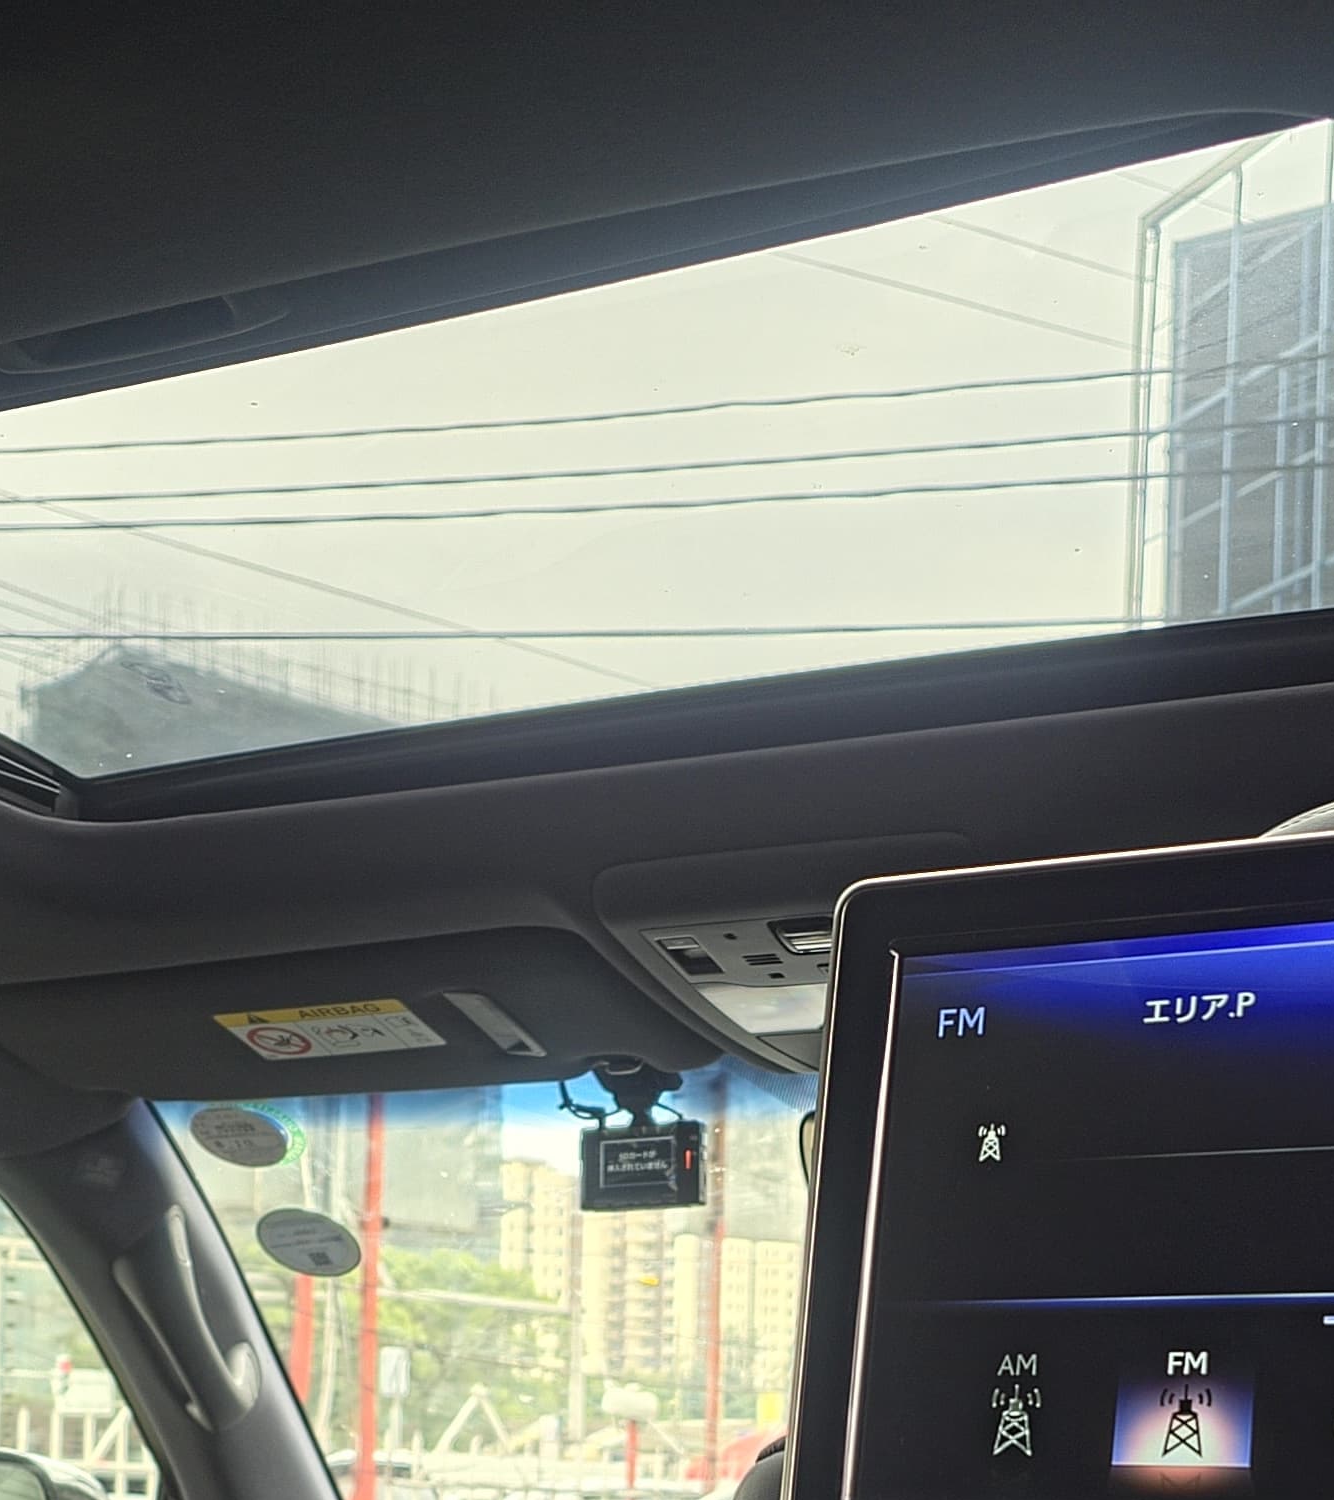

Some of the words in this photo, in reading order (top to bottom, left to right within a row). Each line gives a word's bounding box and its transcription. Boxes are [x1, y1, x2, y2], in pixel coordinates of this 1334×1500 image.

[297, 1003, 381, 1020] AIRBAG
[937, 1005, 987, 1039] FM
[1142, 991, 1257, 1026] エリア.P
[997, 1353, 1038, 1377] AM
[1166, 1350, 1209, 1377] FM
